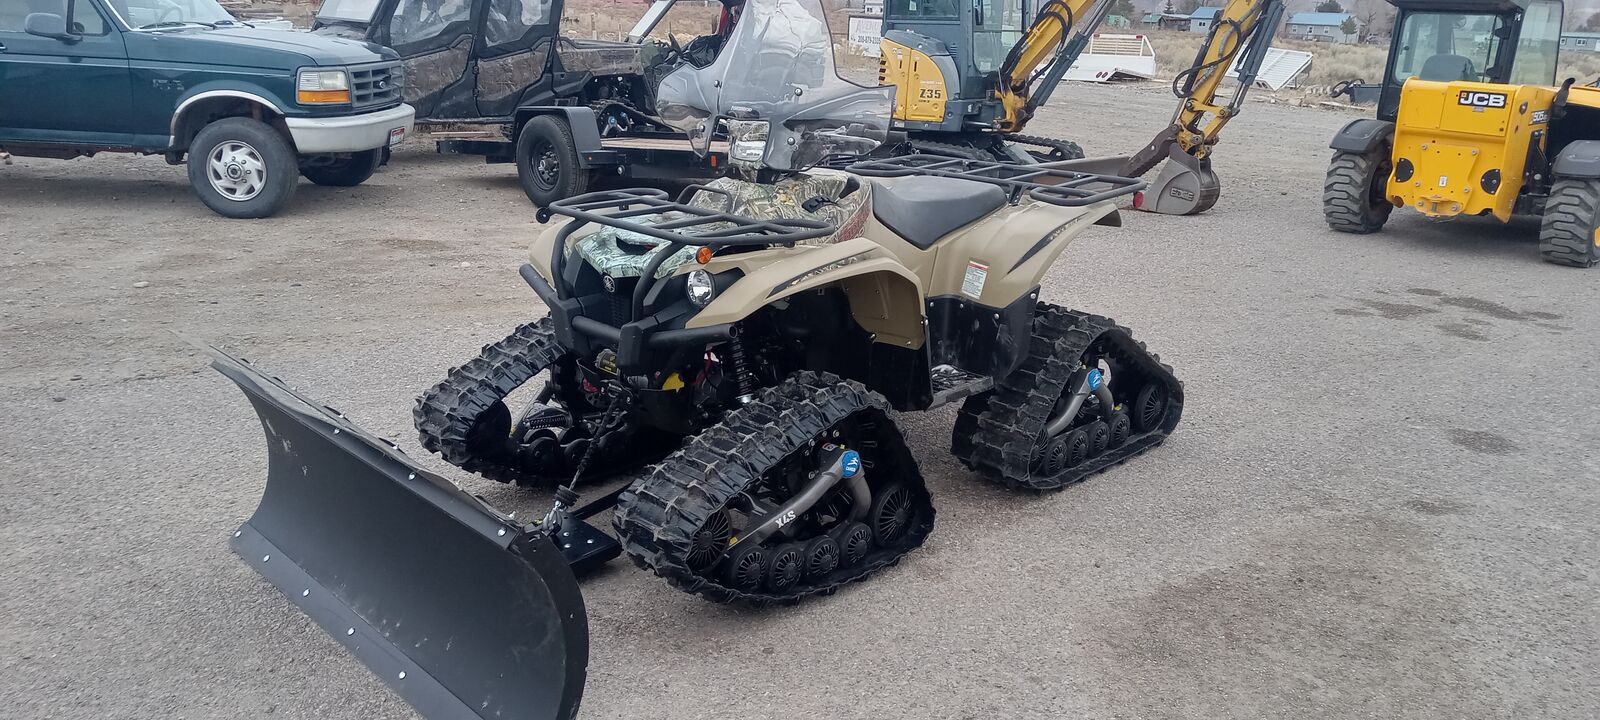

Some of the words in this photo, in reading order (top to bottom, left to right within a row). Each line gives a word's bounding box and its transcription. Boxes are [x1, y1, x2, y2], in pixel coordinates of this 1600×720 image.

[920, 89, 941, 99] Z35
[1460, 92, 1506, 107] JCB
[1170, 187, 1194, 201] EDGE
[775, 510, 796, 528] X4S
